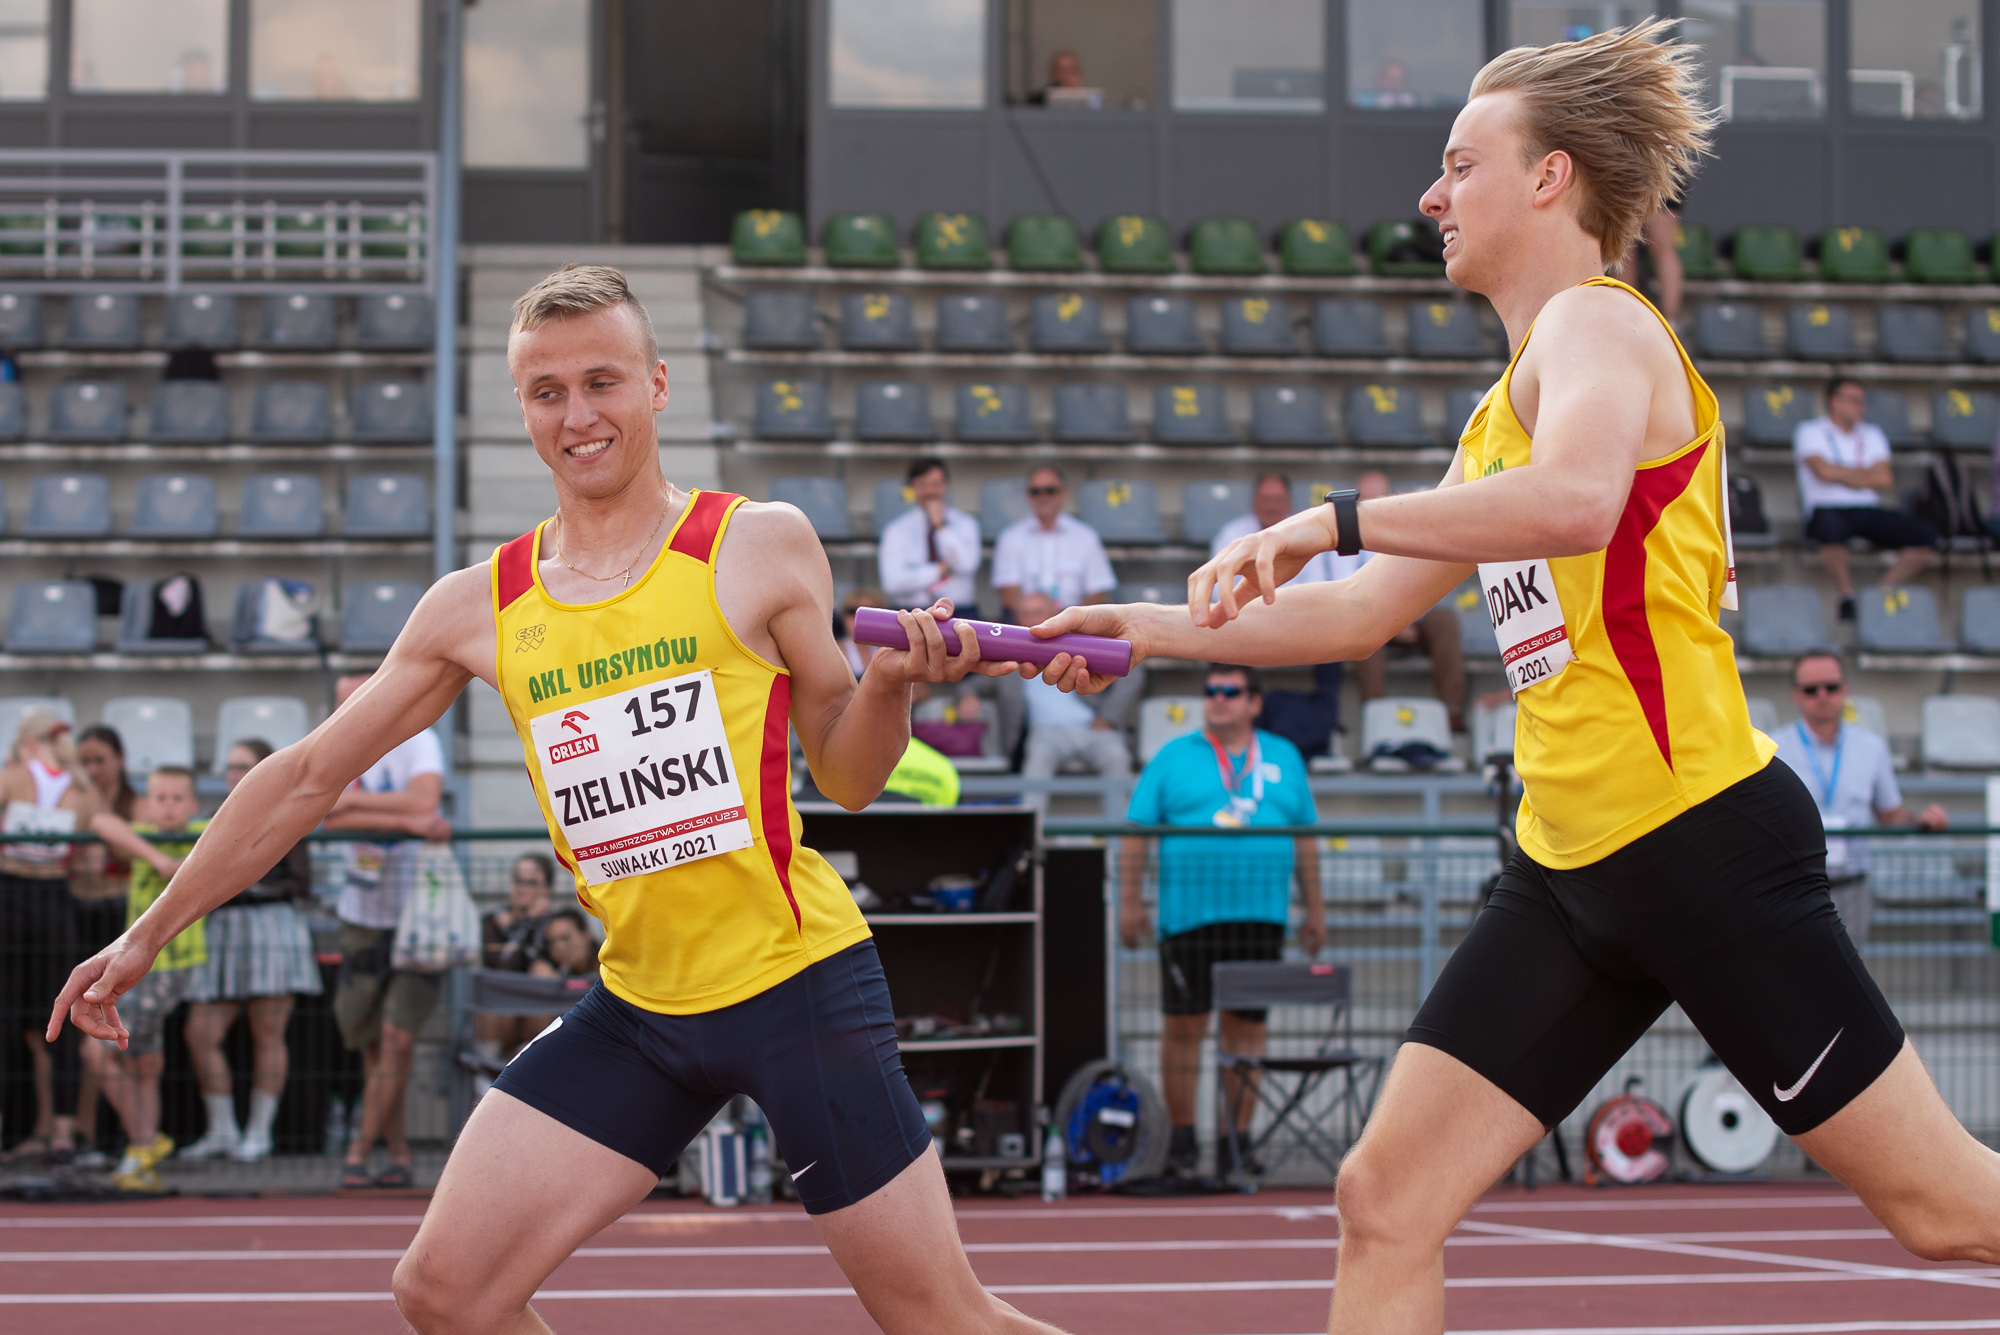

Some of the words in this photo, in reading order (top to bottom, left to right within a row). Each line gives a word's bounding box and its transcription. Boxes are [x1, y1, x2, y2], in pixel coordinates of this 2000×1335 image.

[989, 624, 1003, 637] 3
[1517, 637, 1544, 655] POLSKI
[1544, 630, 1563, 643] U23
[528, 667, 572, 704] AKL
[577, 636, 698, 690] URSYNÓW
[1517, 656, 1553, 685] 2021
[624, 680, 702, 737] 157
[551, 736, 597, 763] ORLEN
[554, 745, 730, 827] ZIELIŃSKI
[589, 844, 610, 857] PZLA
[609, 827, 676, 851] MISTRZOSTWA
[676, 815, 713, 834] POLSKI
[714, 810, 740, 823] U23
[600, 847, 669, 878] SUWAŁKI
[672, 834, 718, 861] 2021
